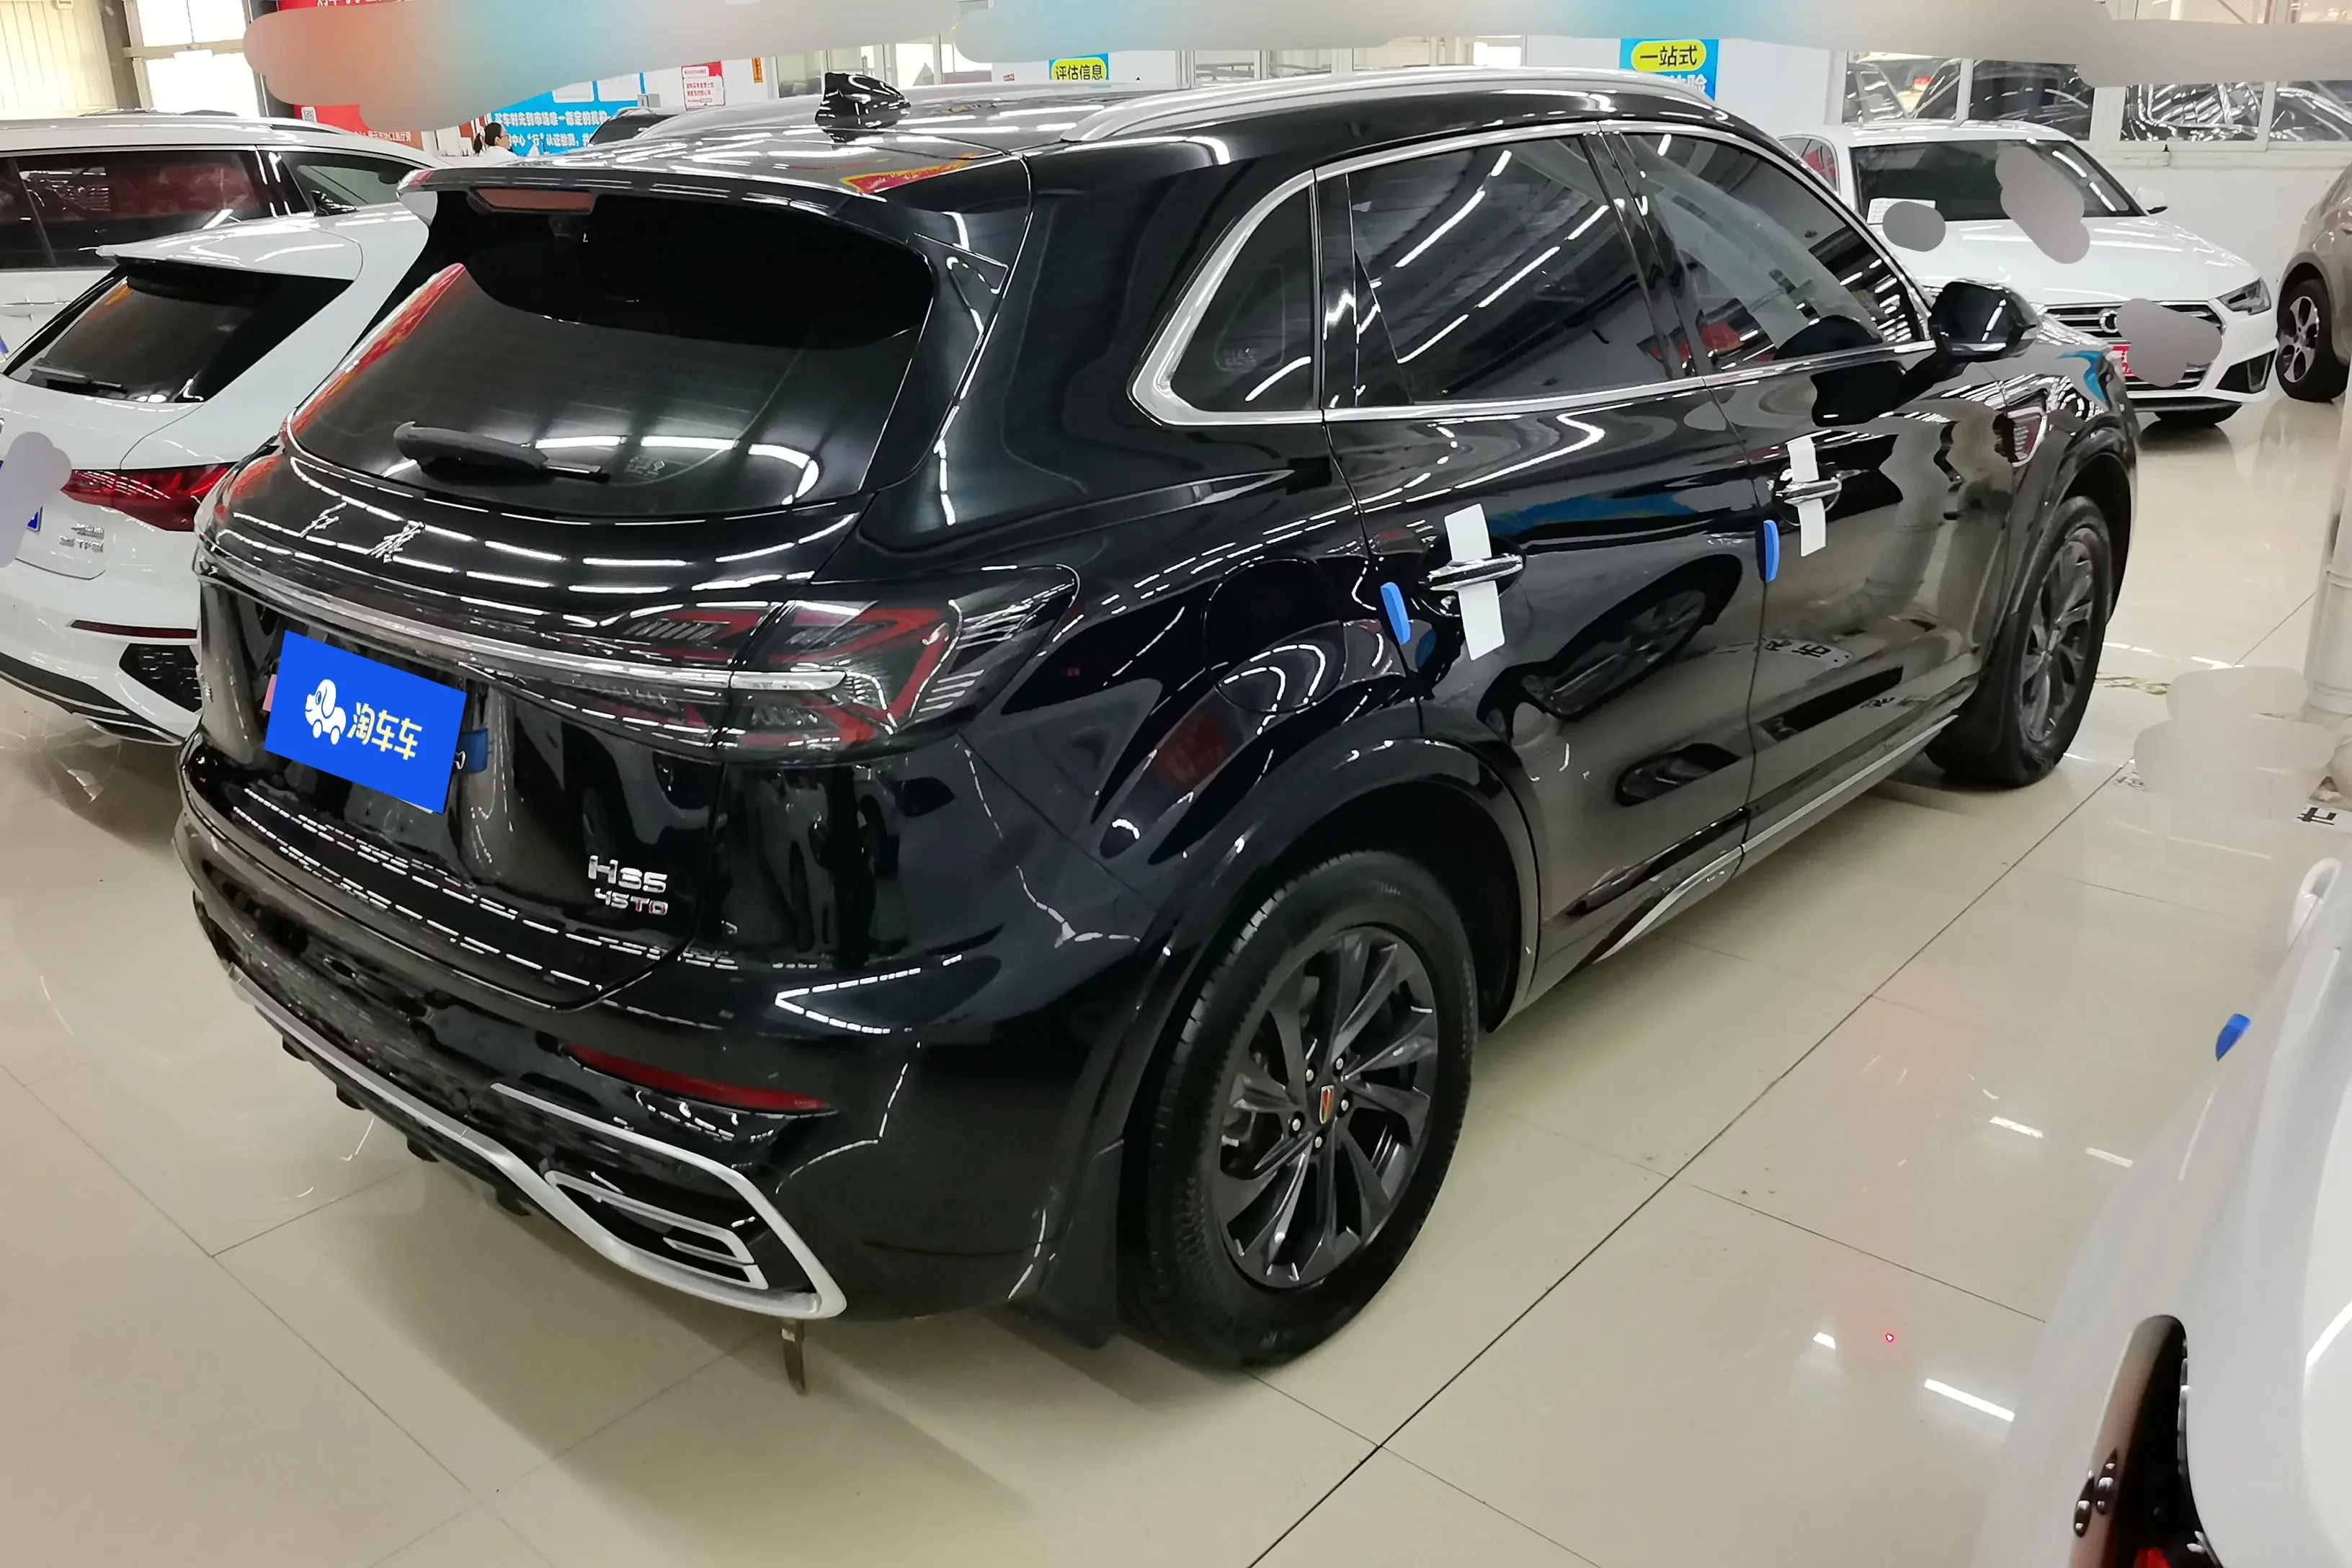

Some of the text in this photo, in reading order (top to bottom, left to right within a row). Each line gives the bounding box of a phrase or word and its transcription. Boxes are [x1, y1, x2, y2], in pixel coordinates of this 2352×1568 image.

[1640, 45, 1697, 67] 一站式
[1056, 64, 1102, 81] 评估信息
[588, 855, 667, 893] HS5
